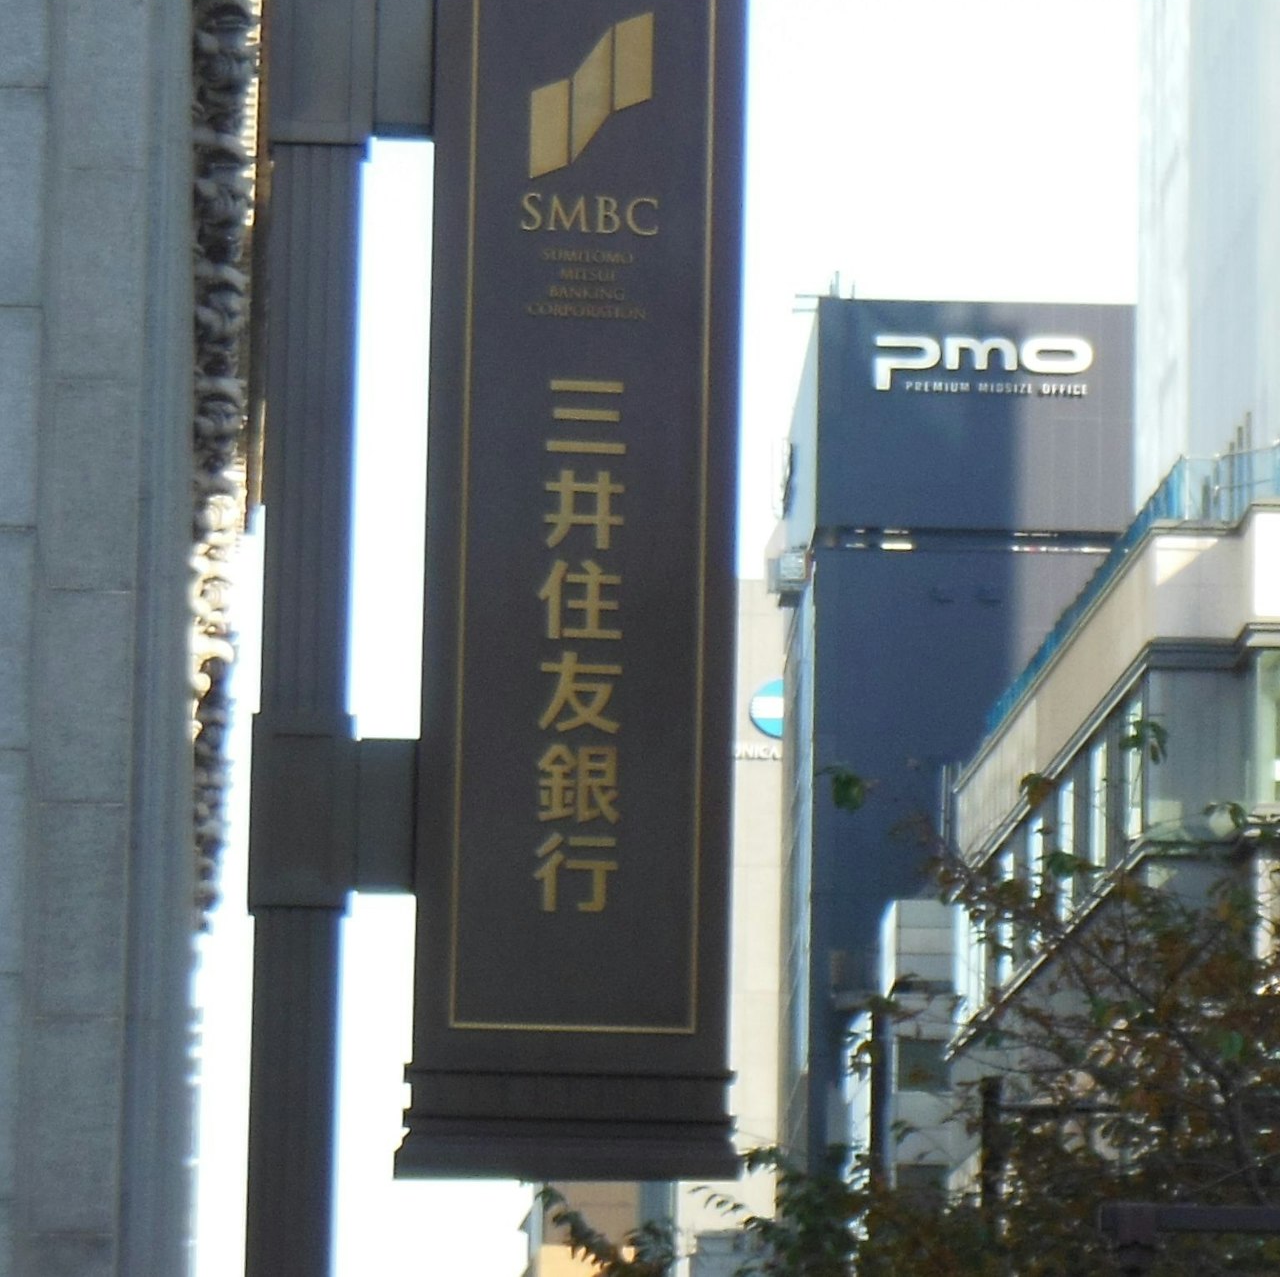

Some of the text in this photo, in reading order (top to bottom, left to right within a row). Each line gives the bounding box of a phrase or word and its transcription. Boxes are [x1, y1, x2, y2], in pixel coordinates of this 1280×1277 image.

[520, 192, 660, 236] SMBC
[548, 284, 625, 301] BANKING
[874, 335, 1093, 391] pmo
[905, 380, 970, 392] PREMIUM
[1041, 383, 1088, 395] OFFICE
[533, 378, 627, 914] 三井住友銀行
